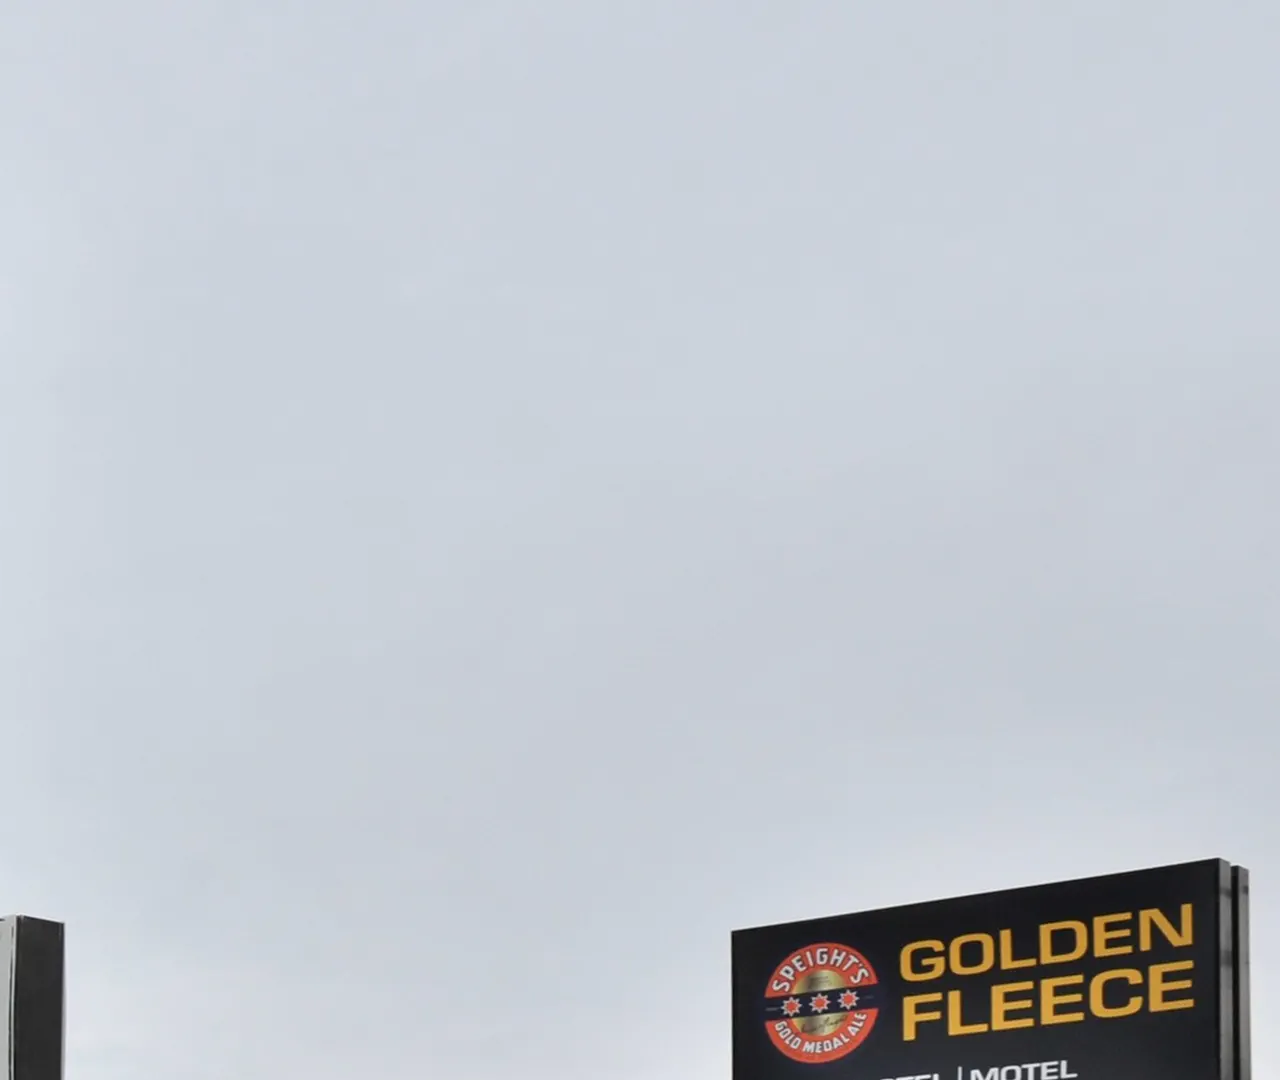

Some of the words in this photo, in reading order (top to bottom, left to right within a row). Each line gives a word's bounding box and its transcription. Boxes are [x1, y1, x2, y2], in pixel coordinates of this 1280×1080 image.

[772, 948, 869, 992] SPEIGHT'S
[900, 903, 1193, 982] GOLDEN
[902, 960, 1194, 1041] FLEECE
[774, 1021, 802, 1049] GOLD
[802, 1034, 850, 1053] MEDAL
[847, 1012, 867, 1036] ALE
